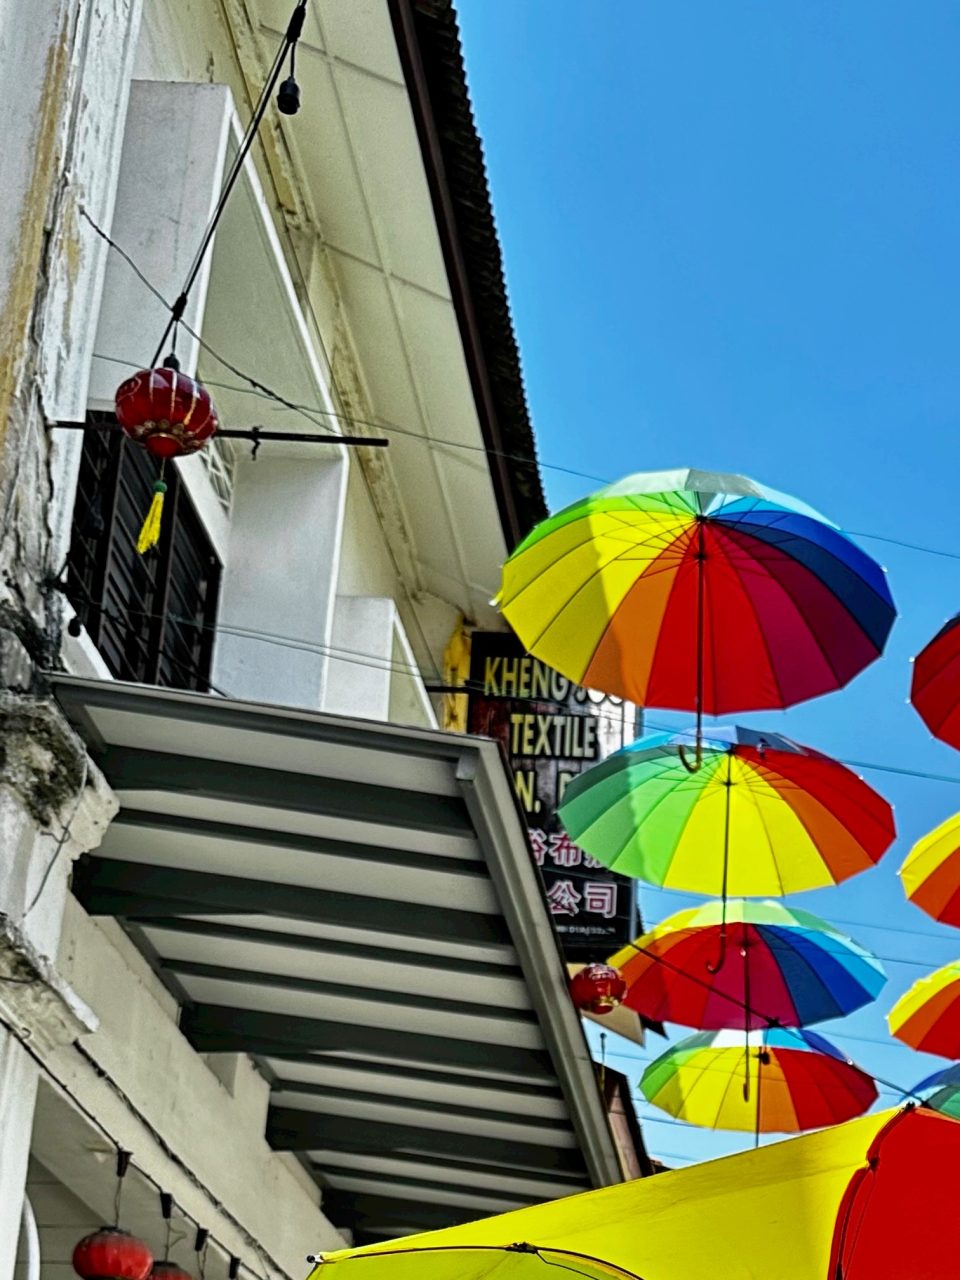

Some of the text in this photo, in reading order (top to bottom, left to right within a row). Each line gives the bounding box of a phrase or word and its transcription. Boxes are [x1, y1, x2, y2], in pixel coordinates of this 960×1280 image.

[484, 657, 569, 701] KHENG
[511, 713, 596, 757] TEXTILE
[548, 880, 618, 918] 公司
